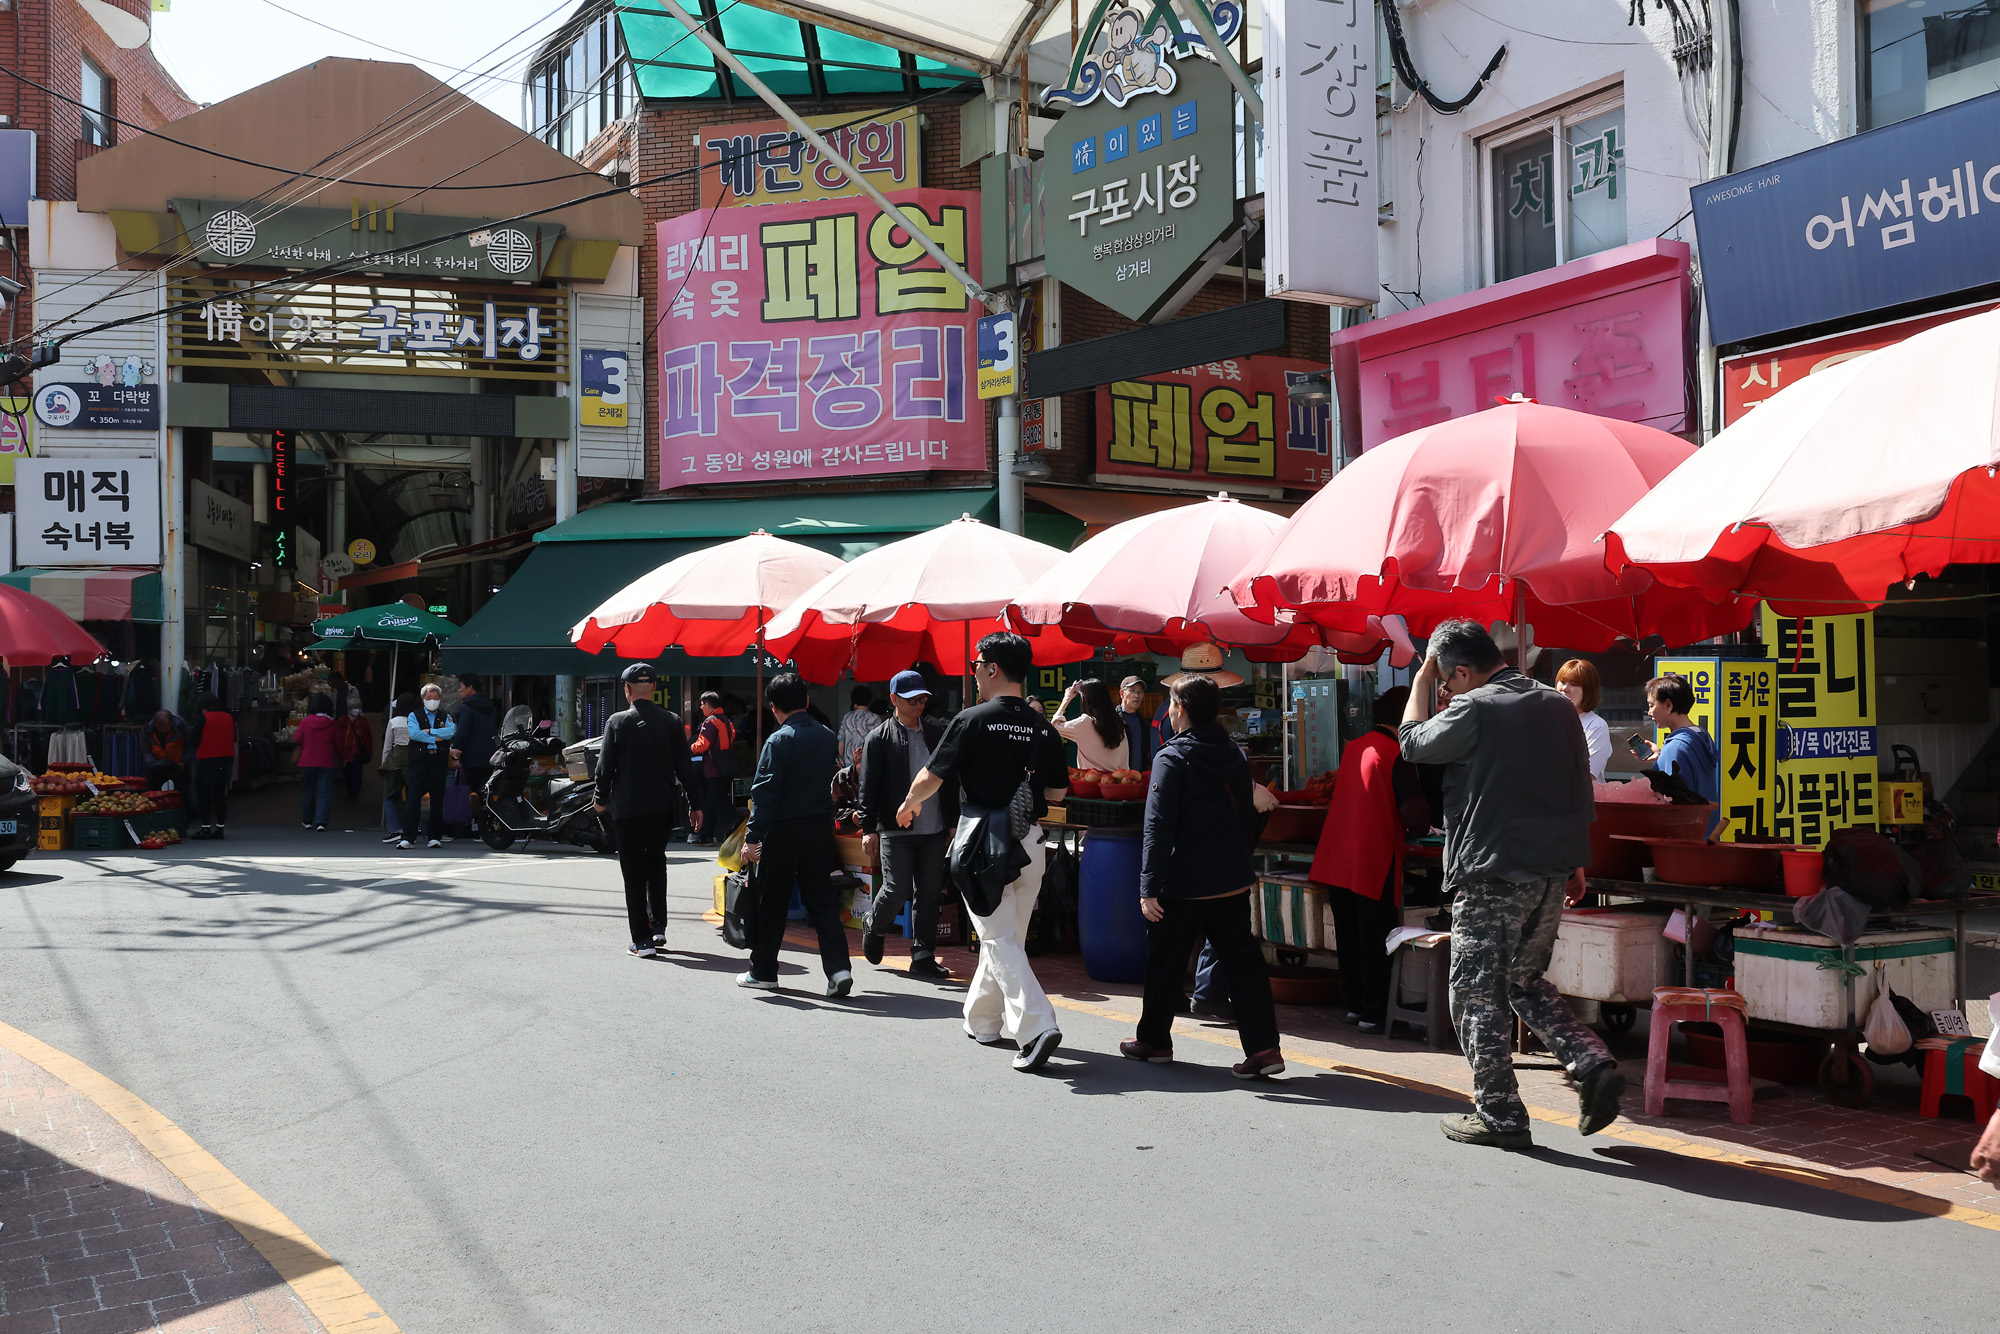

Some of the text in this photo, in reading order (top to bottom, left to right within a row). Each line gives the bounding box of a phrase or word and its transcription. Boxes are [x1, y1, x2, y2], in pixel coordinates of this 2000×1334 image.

[1298, 0, 1369, 207] 장품
[705, 120, 905, 196] 계단상회
[1509, 125, 1625, 228] 치과
[1705, 174, 1781, 206] AWESOME HAIR
[1068, 154, 1201, 237] 구포시장
[306, 247, 331, 262] 야채
[397, 253, 420, 267] 거리
[666, 234, 749, 281] 란제리
[760, 202, 968, 323] 폐업
[1115, 258, 1152, 282] 삼거리
[359, 301, 552, 361] 구포시장
[993, 319, 1014, 372] 3
[113, 390, 151, 405] 다락방
[584, 356, 628, 405] Gate 3
[664, 325, 966, 439] 파격정리
[980, 374, 1012, 390] 삼거리상우회
[598, 407, 623, 419] 은제길
[1024, 401, 1043, 423] 유통
[1109, 380, 1276, 479] 폐업
[681, 439, 949, 473] 그 동안 성원에 감사드립니다
[44, 470, 130, 513] 매직
[41, 521, 135, 551] 숙녀복
[356, 541, 367, 550] 닭
[352, 550, 372, 560] 오리
[1777, 618, 1867, 718] 틀니
[1728, 671, 1770, 707] 즐거운
[1008, 734, 1031, 742] PARIS
[1823, 730, 1872, 755] 야간진료
[1934, 1013, 1965, 1034] 돌미역
